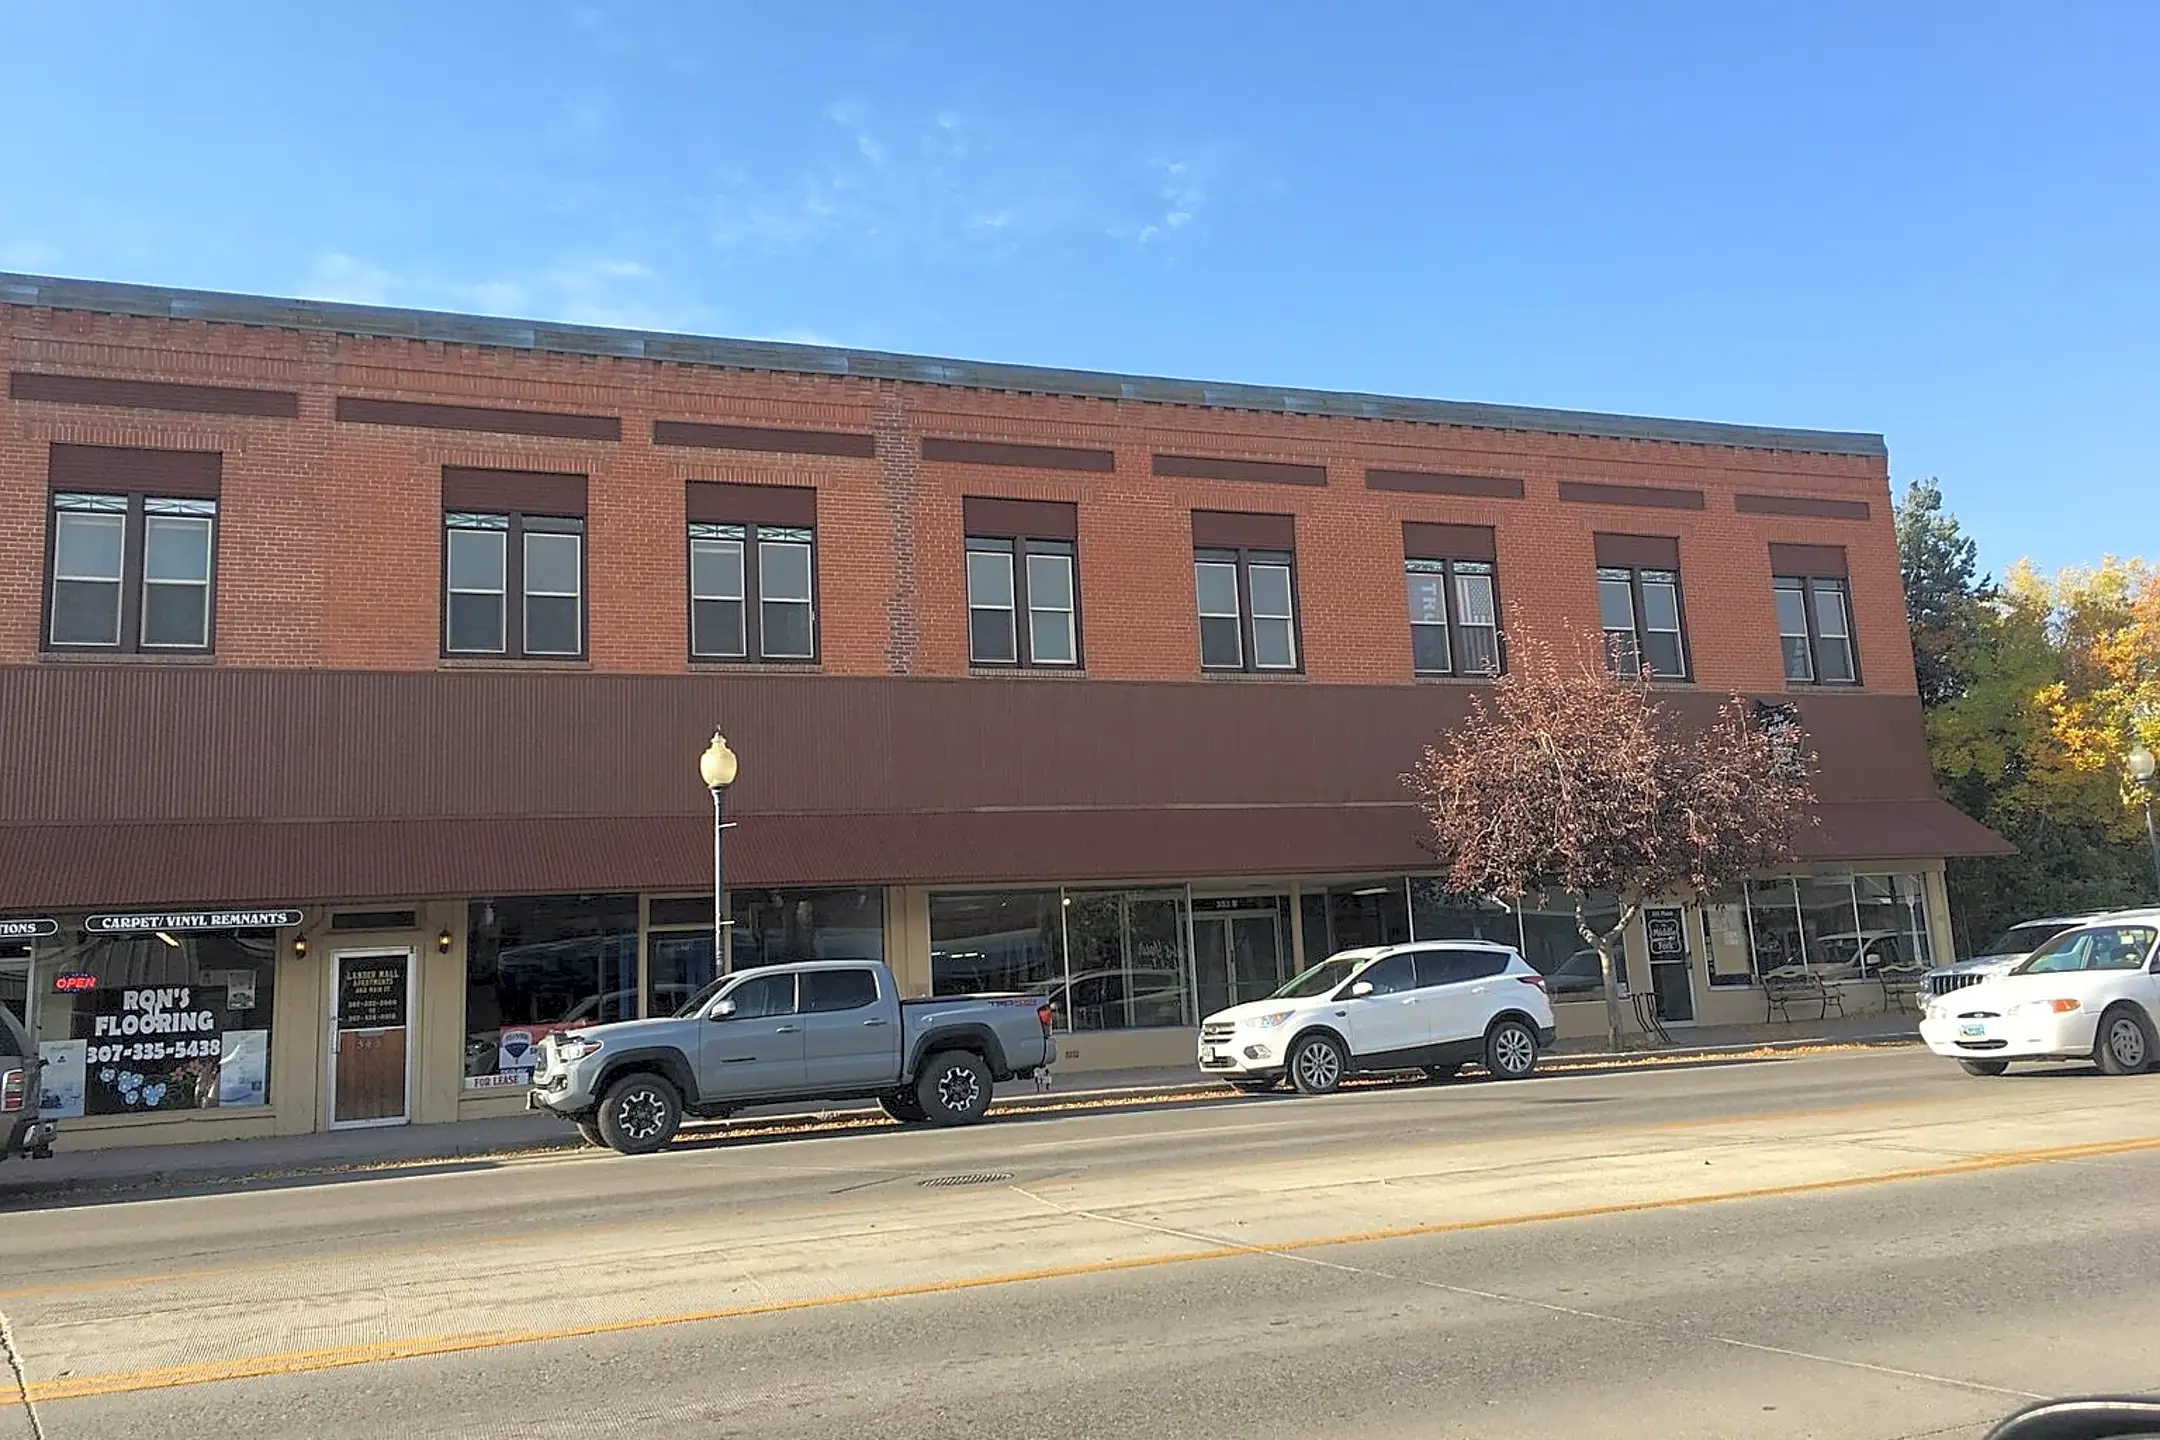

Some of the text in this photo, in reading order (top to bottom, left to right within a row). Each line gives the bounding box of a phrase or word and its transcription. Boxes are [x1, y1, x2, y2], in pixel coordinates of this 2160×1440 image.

[211, 913, 288, 926] REMNANTS
[56, 976, 97, 989] OPEN
[123, 987, 190, 1010] RON'S
[95, 1010, 214, 1036] FLOORING
[87, 1039, 220, 1063] 307-335-5438
[474, 1075, 520, 1087] FOR LEASE
